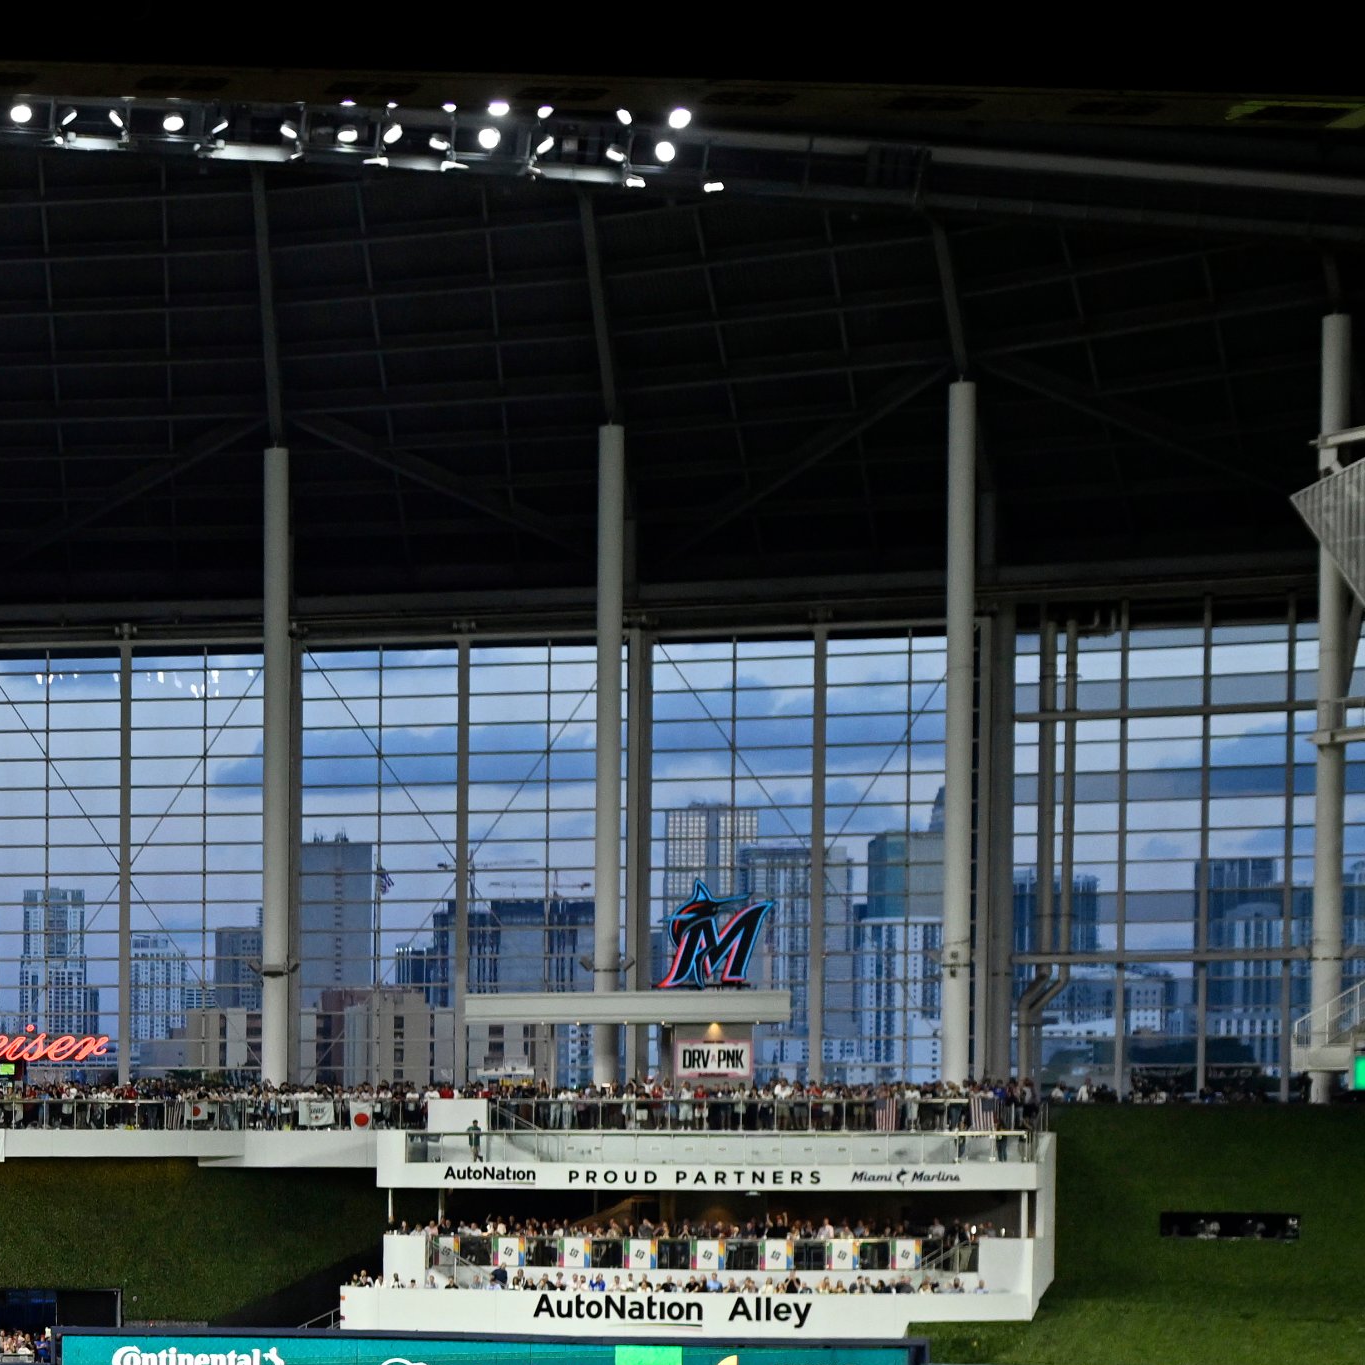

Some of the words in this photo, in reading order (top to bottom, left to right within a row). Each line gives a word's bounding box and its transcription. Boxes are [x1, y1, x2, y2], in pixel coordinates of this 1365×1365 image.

[682, 1049, 710, 1069] DRV
[718, 1049, 744, 1069] PNK
[444, 1165, 536, 1181] AutoNation
[569, 1170, 658, 1185] PROUD
[676, 1170, 822, 1185] PARTNERS
[851, 1170, 893, 1183] Miami
[911, 1170, 961, 1183] Marlins
[533, 1294, 703, 1321] AutoNation
[729, 1297, 812, 1328] Alley
